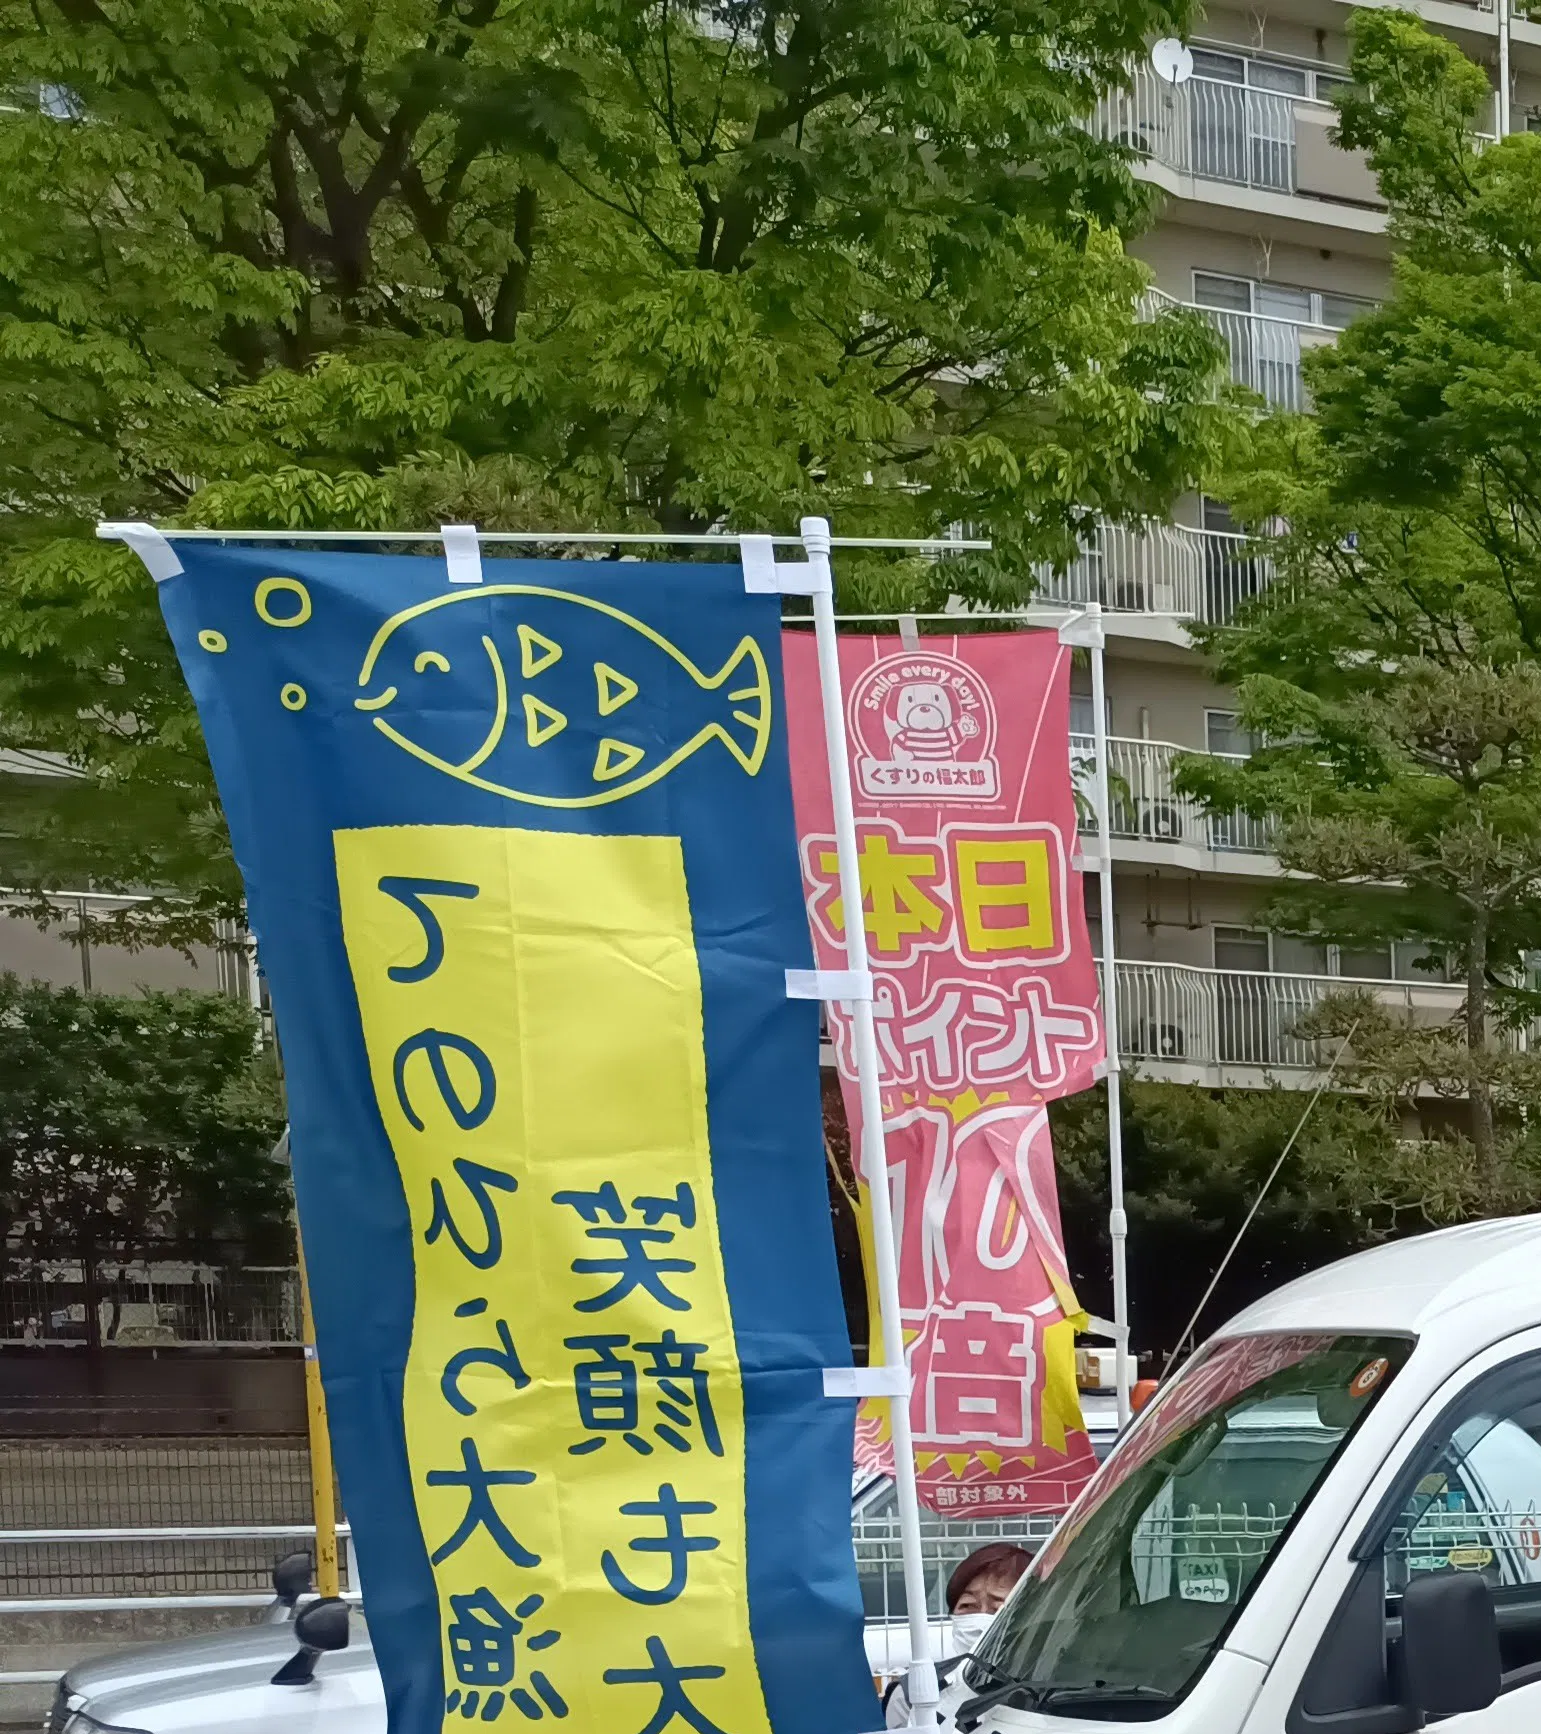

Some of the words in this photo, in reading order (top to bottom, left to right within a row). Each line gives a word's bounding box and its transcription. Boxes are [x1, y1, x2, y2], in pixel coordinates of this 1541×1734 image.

[863, 672, 901, 711] Smile
[901, 664, 951, 684] every
[951, 676, 981, 711] day!
[870, 767, 986, 786] くすりの福太郎
[819, 835, 1055, 953] 本日
[840, 985, 1087, 1078] ポイント
